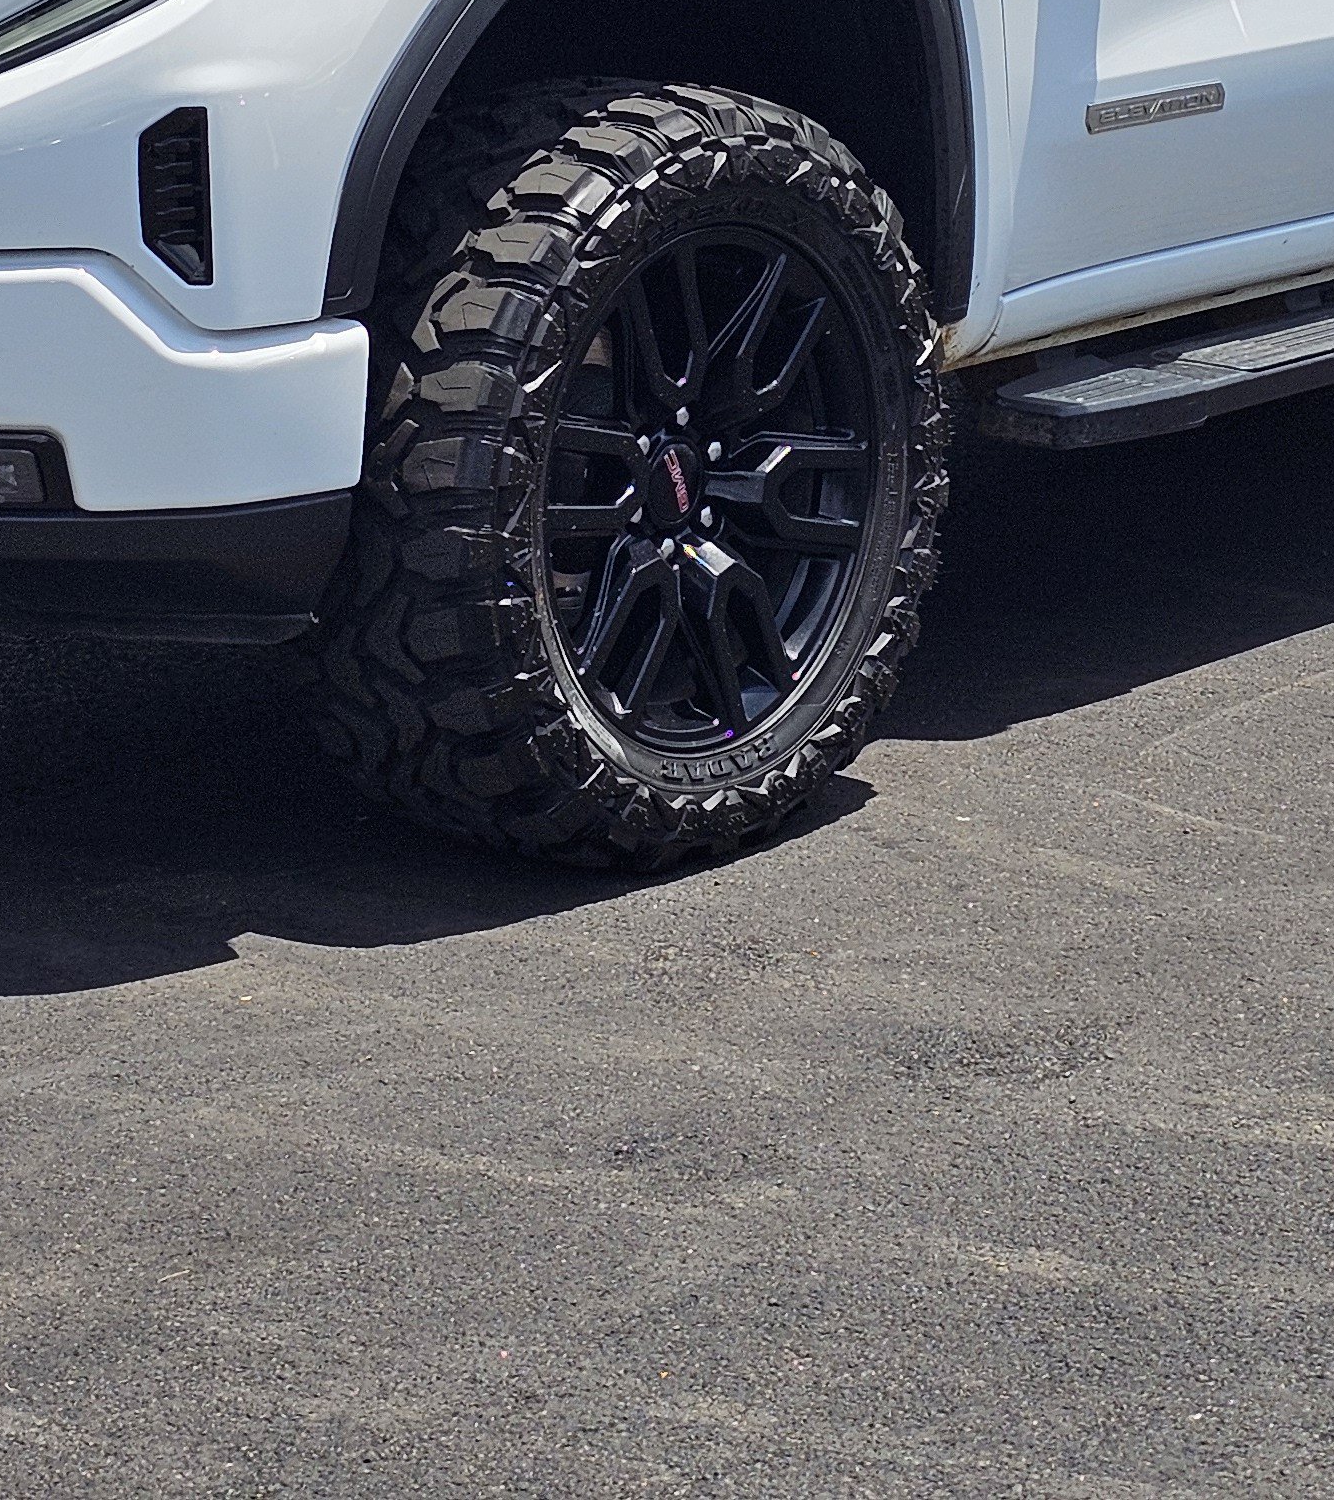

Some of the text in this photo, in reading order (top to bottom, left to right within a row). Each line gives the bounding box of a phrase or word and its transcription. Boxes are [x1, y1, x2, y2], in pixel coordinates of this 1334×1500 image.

[1098, 90, 1217, 123] ELEVATION
[664, 449, 689, 513] GMC
[653, 732, 778, 783] RADAR
